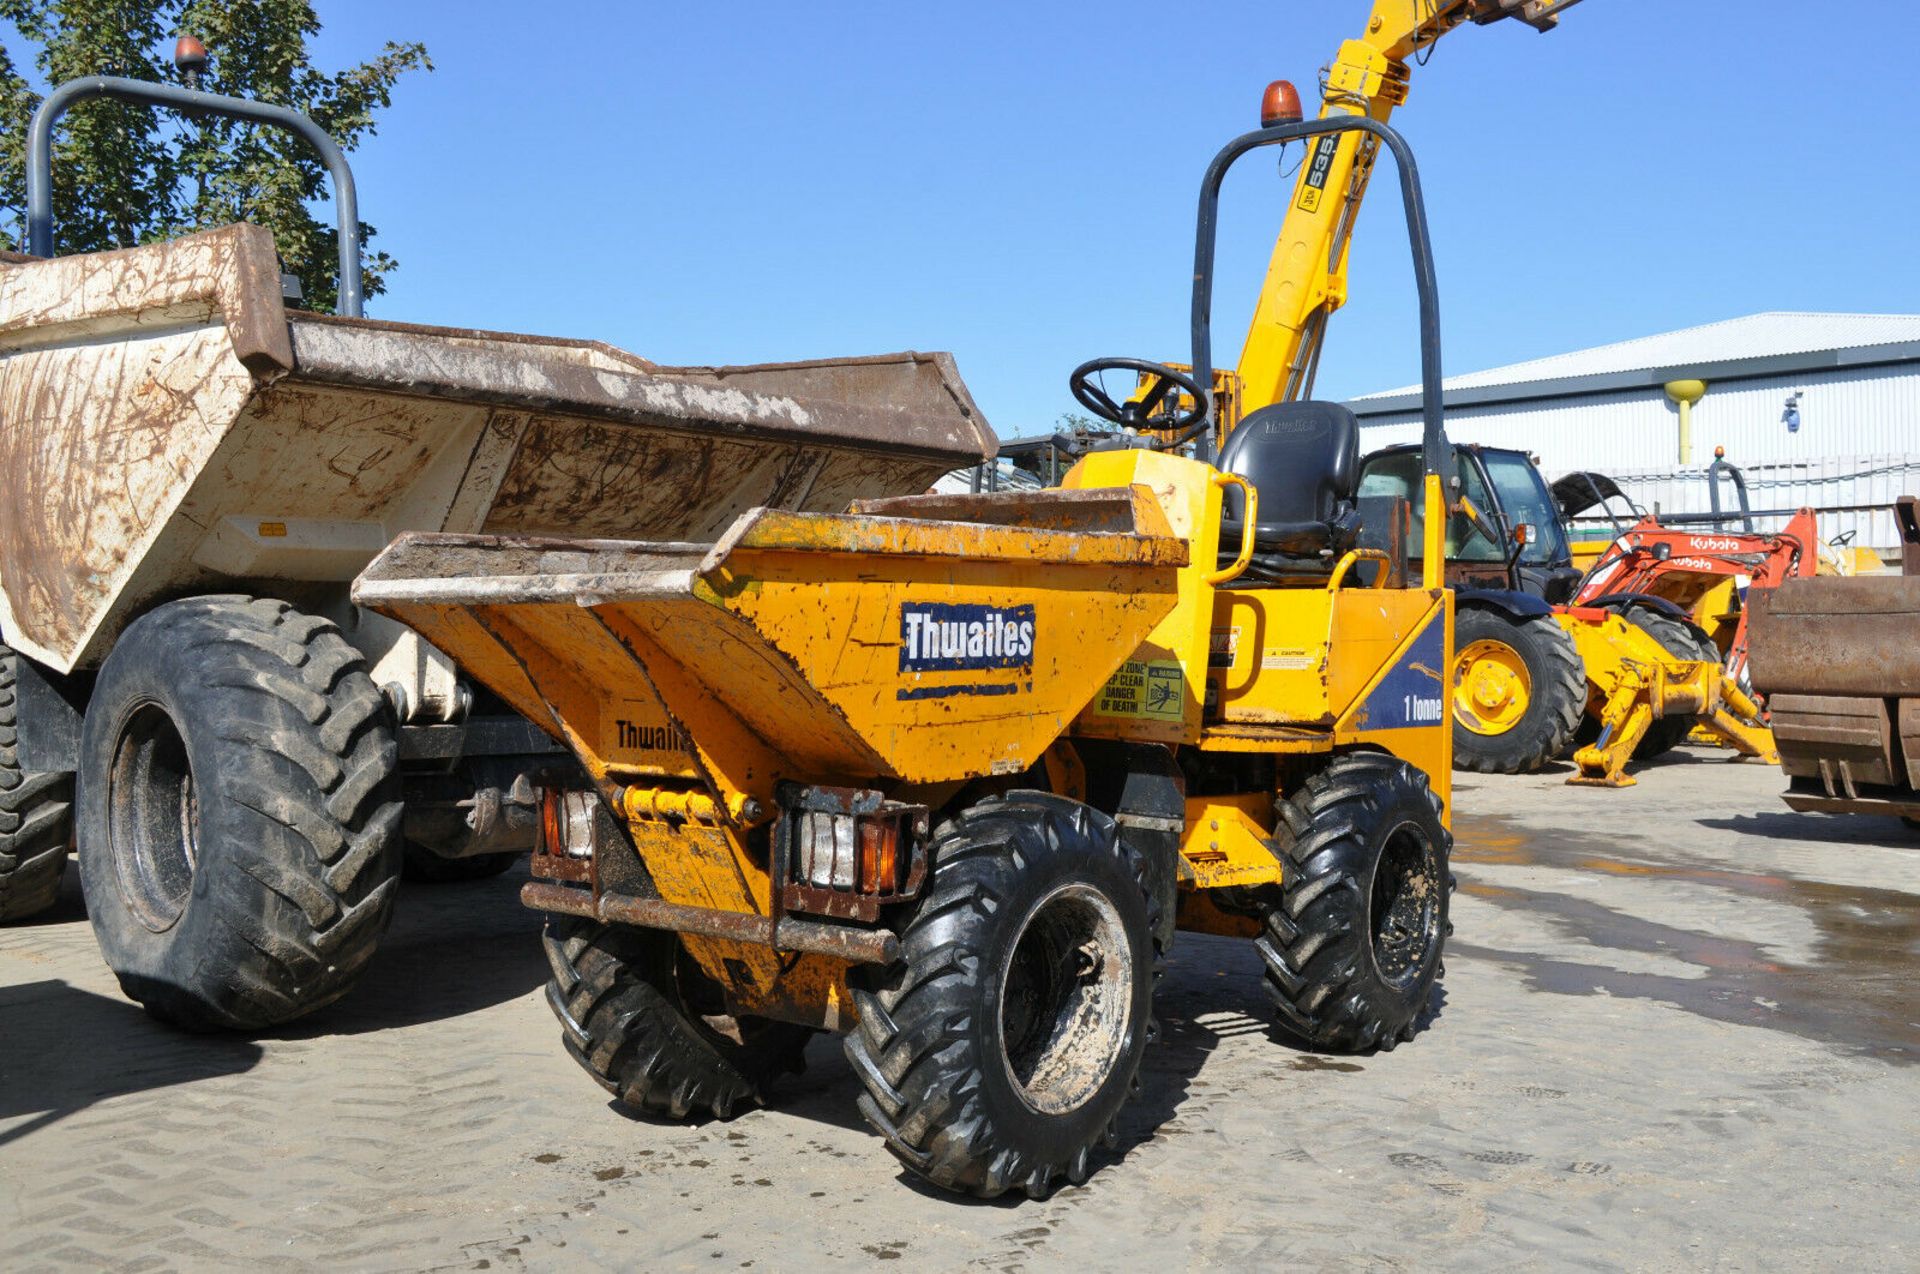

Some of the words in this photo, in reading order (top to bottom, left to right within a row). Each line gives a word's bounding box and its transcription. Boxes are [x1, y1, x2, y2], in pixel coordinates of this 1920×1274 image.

[1690, 537, 1738, 550] Kubota
[905, 613, 1033, 659] Thwaites
[1120, 675, 1144, 686] CLEAR
[1106, 687, 1136, 699] DANGER
[1101, 699, 1110, 711] OF
[1113, 701, 1138, 713] DEATH!
[1404, 695, 1410, 721] 1
[1413, 695, 1442, 720] tonne
[616, 720, 687, 751] Thwait
